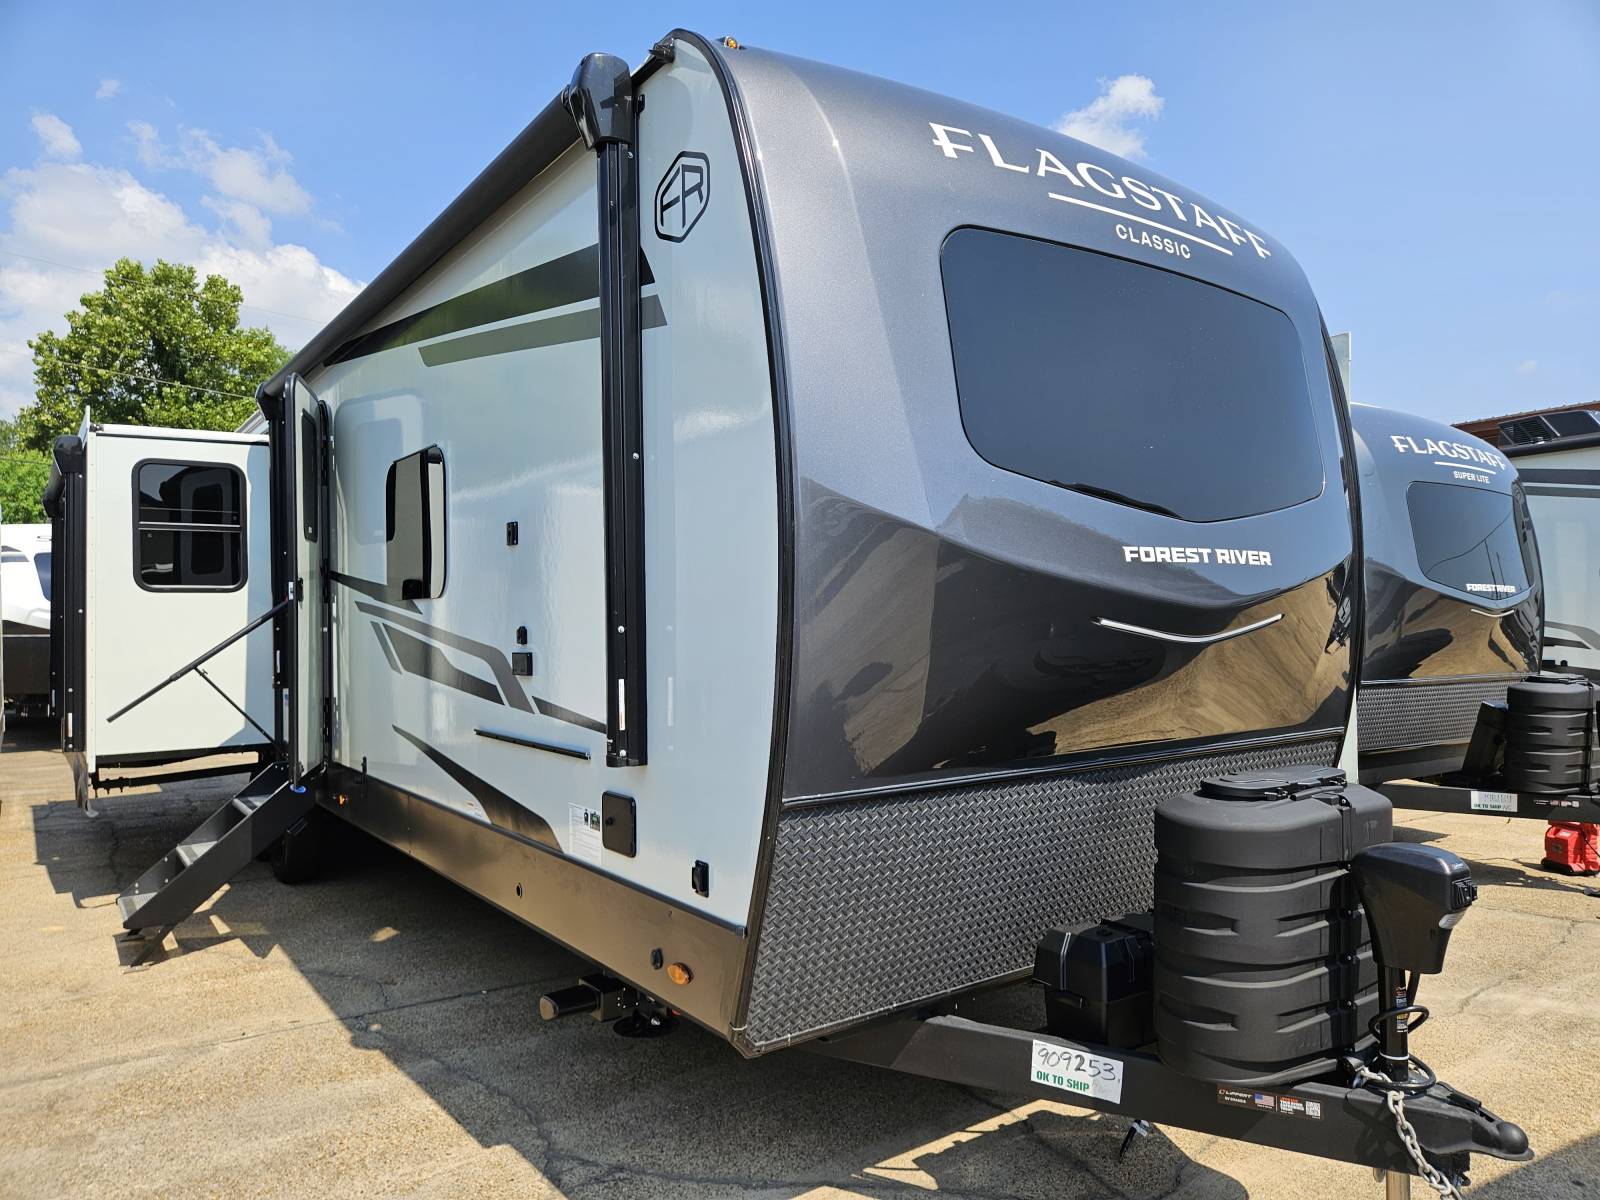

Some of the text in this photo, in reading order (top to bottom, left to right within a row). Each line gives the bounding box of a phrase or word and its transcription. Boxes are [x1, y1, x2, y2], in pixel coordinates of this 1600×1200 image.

[928, 122, 1272, 259] FLAGSTAFF
[1115, 223, 1192, 259] CLASSIC
[1390, 435, 1507, 470] FLAGSTAFF
[1453, 470, 1490, 484] SUPER LITE
[1122, 546, 1273, 566] FOREST RIVER
[1466, 583, 1516, 593] FOREST RIVER
[1038, 1048, 1116, 1080] 909253
[1036, 1071, 1049, 1082] OK
[1052, 1074, 1064, 1086] TO
[1066, 1079, 1090, 1092] SHIP
